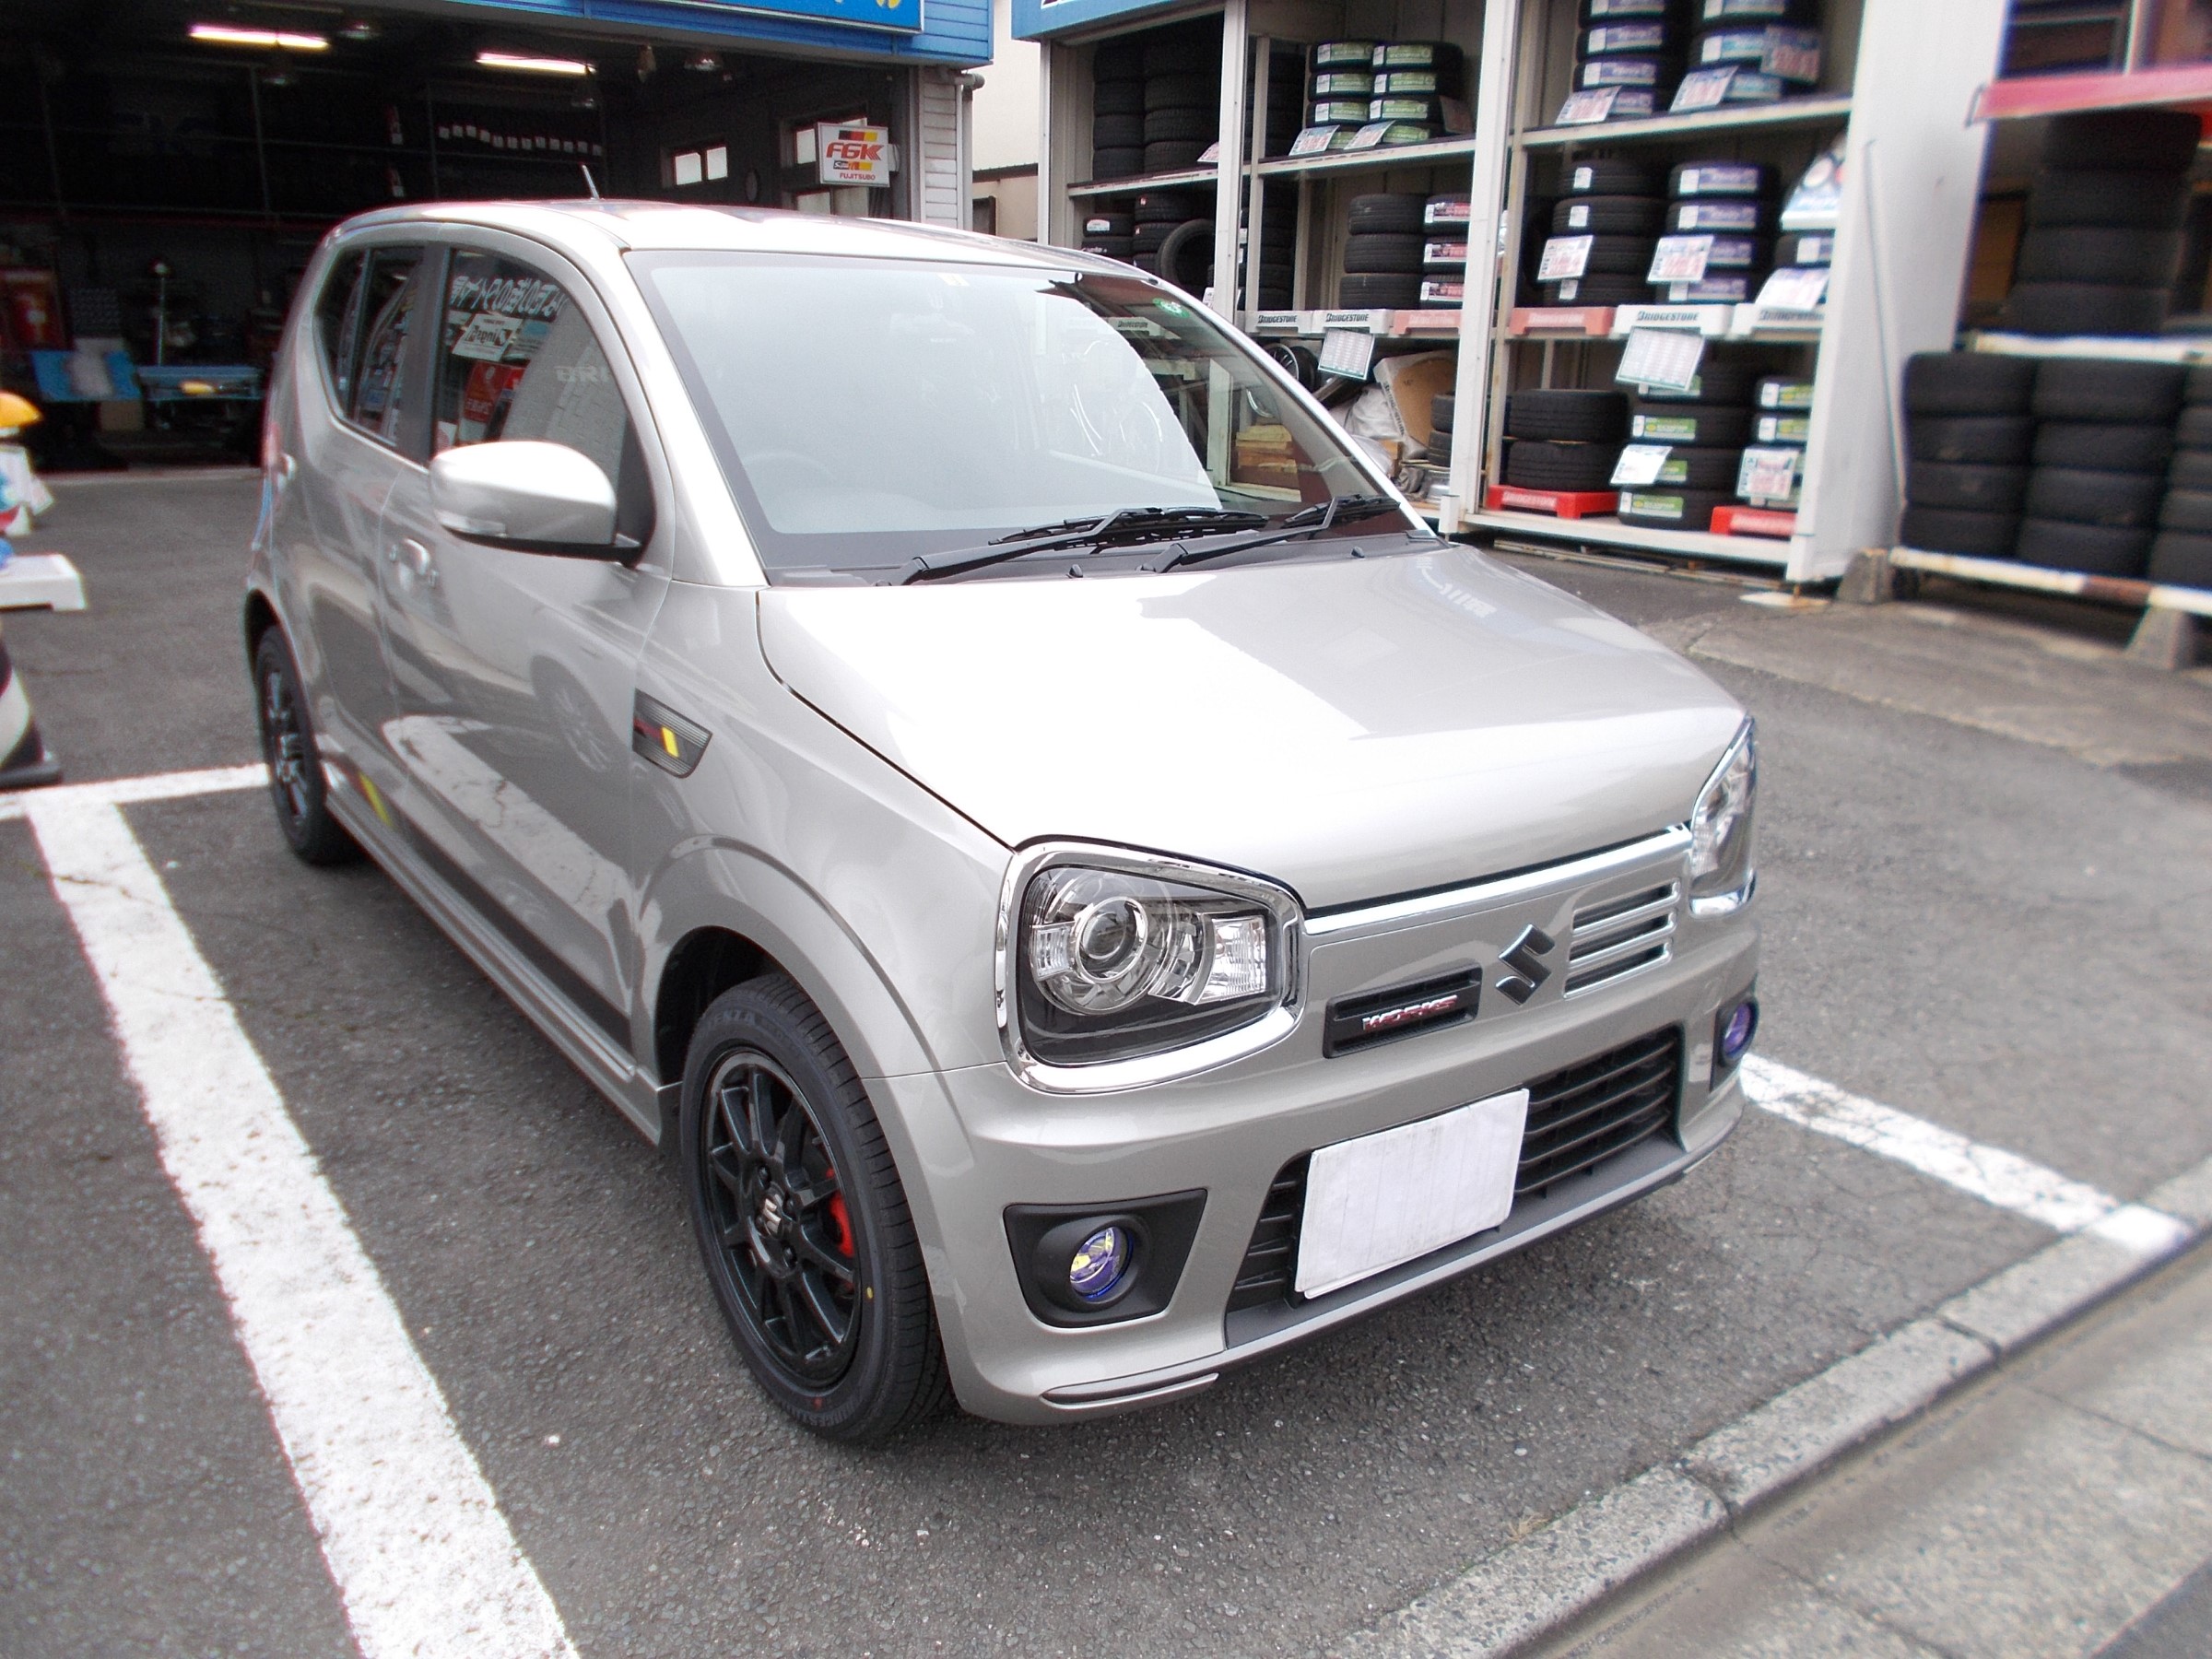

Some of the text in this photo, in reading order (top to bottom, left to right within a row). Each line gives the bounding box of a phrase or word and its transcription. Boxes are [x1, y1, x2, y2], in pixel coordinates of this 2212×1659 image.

[826, 142, 885, 161] FGK
[840, 172, 877, 181] FUJITSUBO
[1258, 315, 1298, 324] BRIDGESTONE
[1325, 312, 1370, 322] BRIDGESTONE
[1636, 311, 1700, 322] BRIDGESTONE
